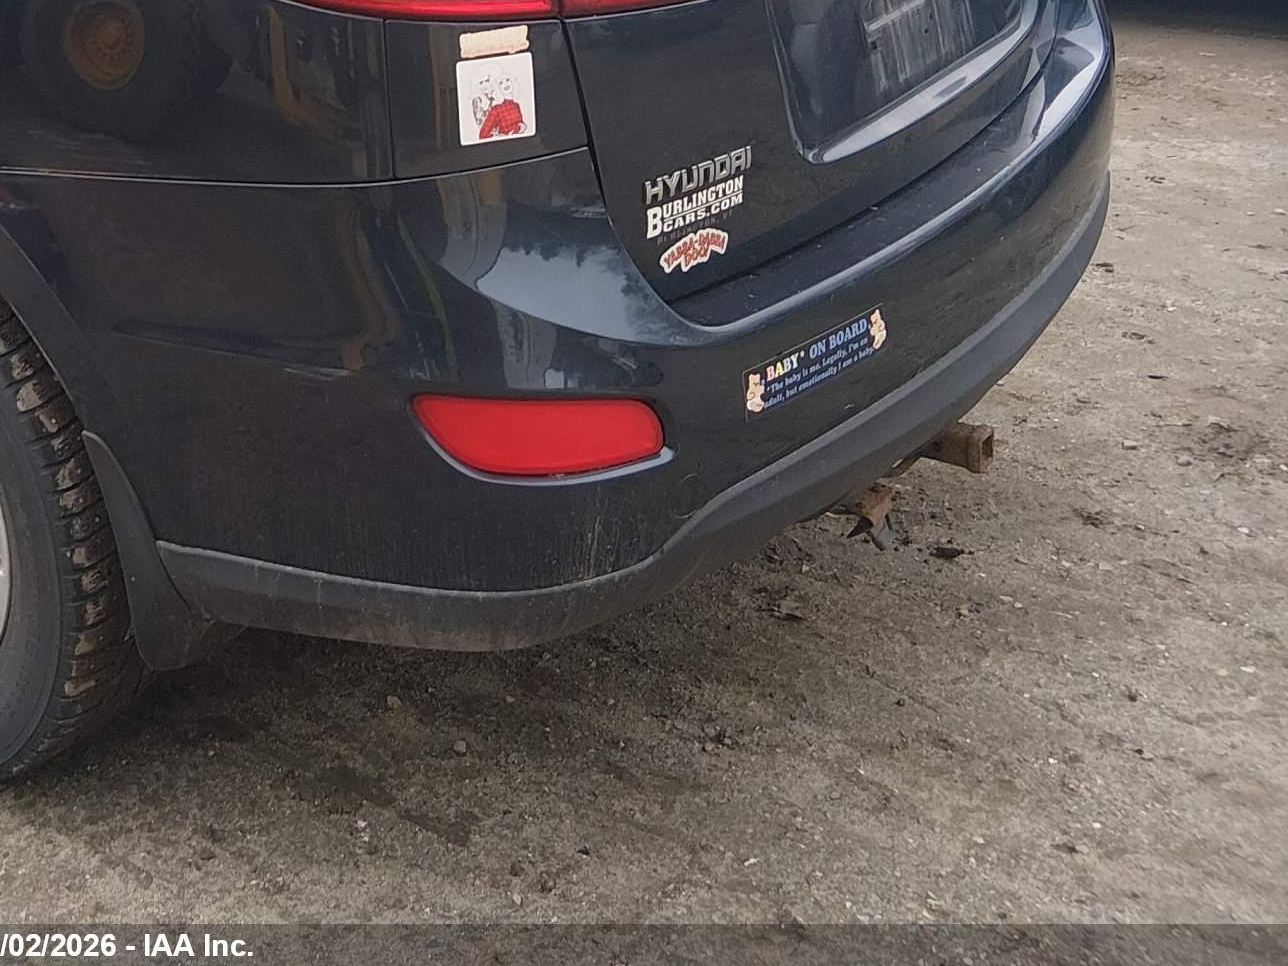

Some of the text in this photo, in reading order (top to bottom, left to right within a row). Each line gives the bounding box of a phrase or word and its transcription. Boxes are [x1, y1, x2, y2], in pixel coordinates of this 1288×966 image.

[643, 145, 752, 205] HYUNDAI
[646, 174, 744, 239] BURLINGTON
[663, 192, 743, 232] CARS.COM
[809, 338, 826, 359] ON
